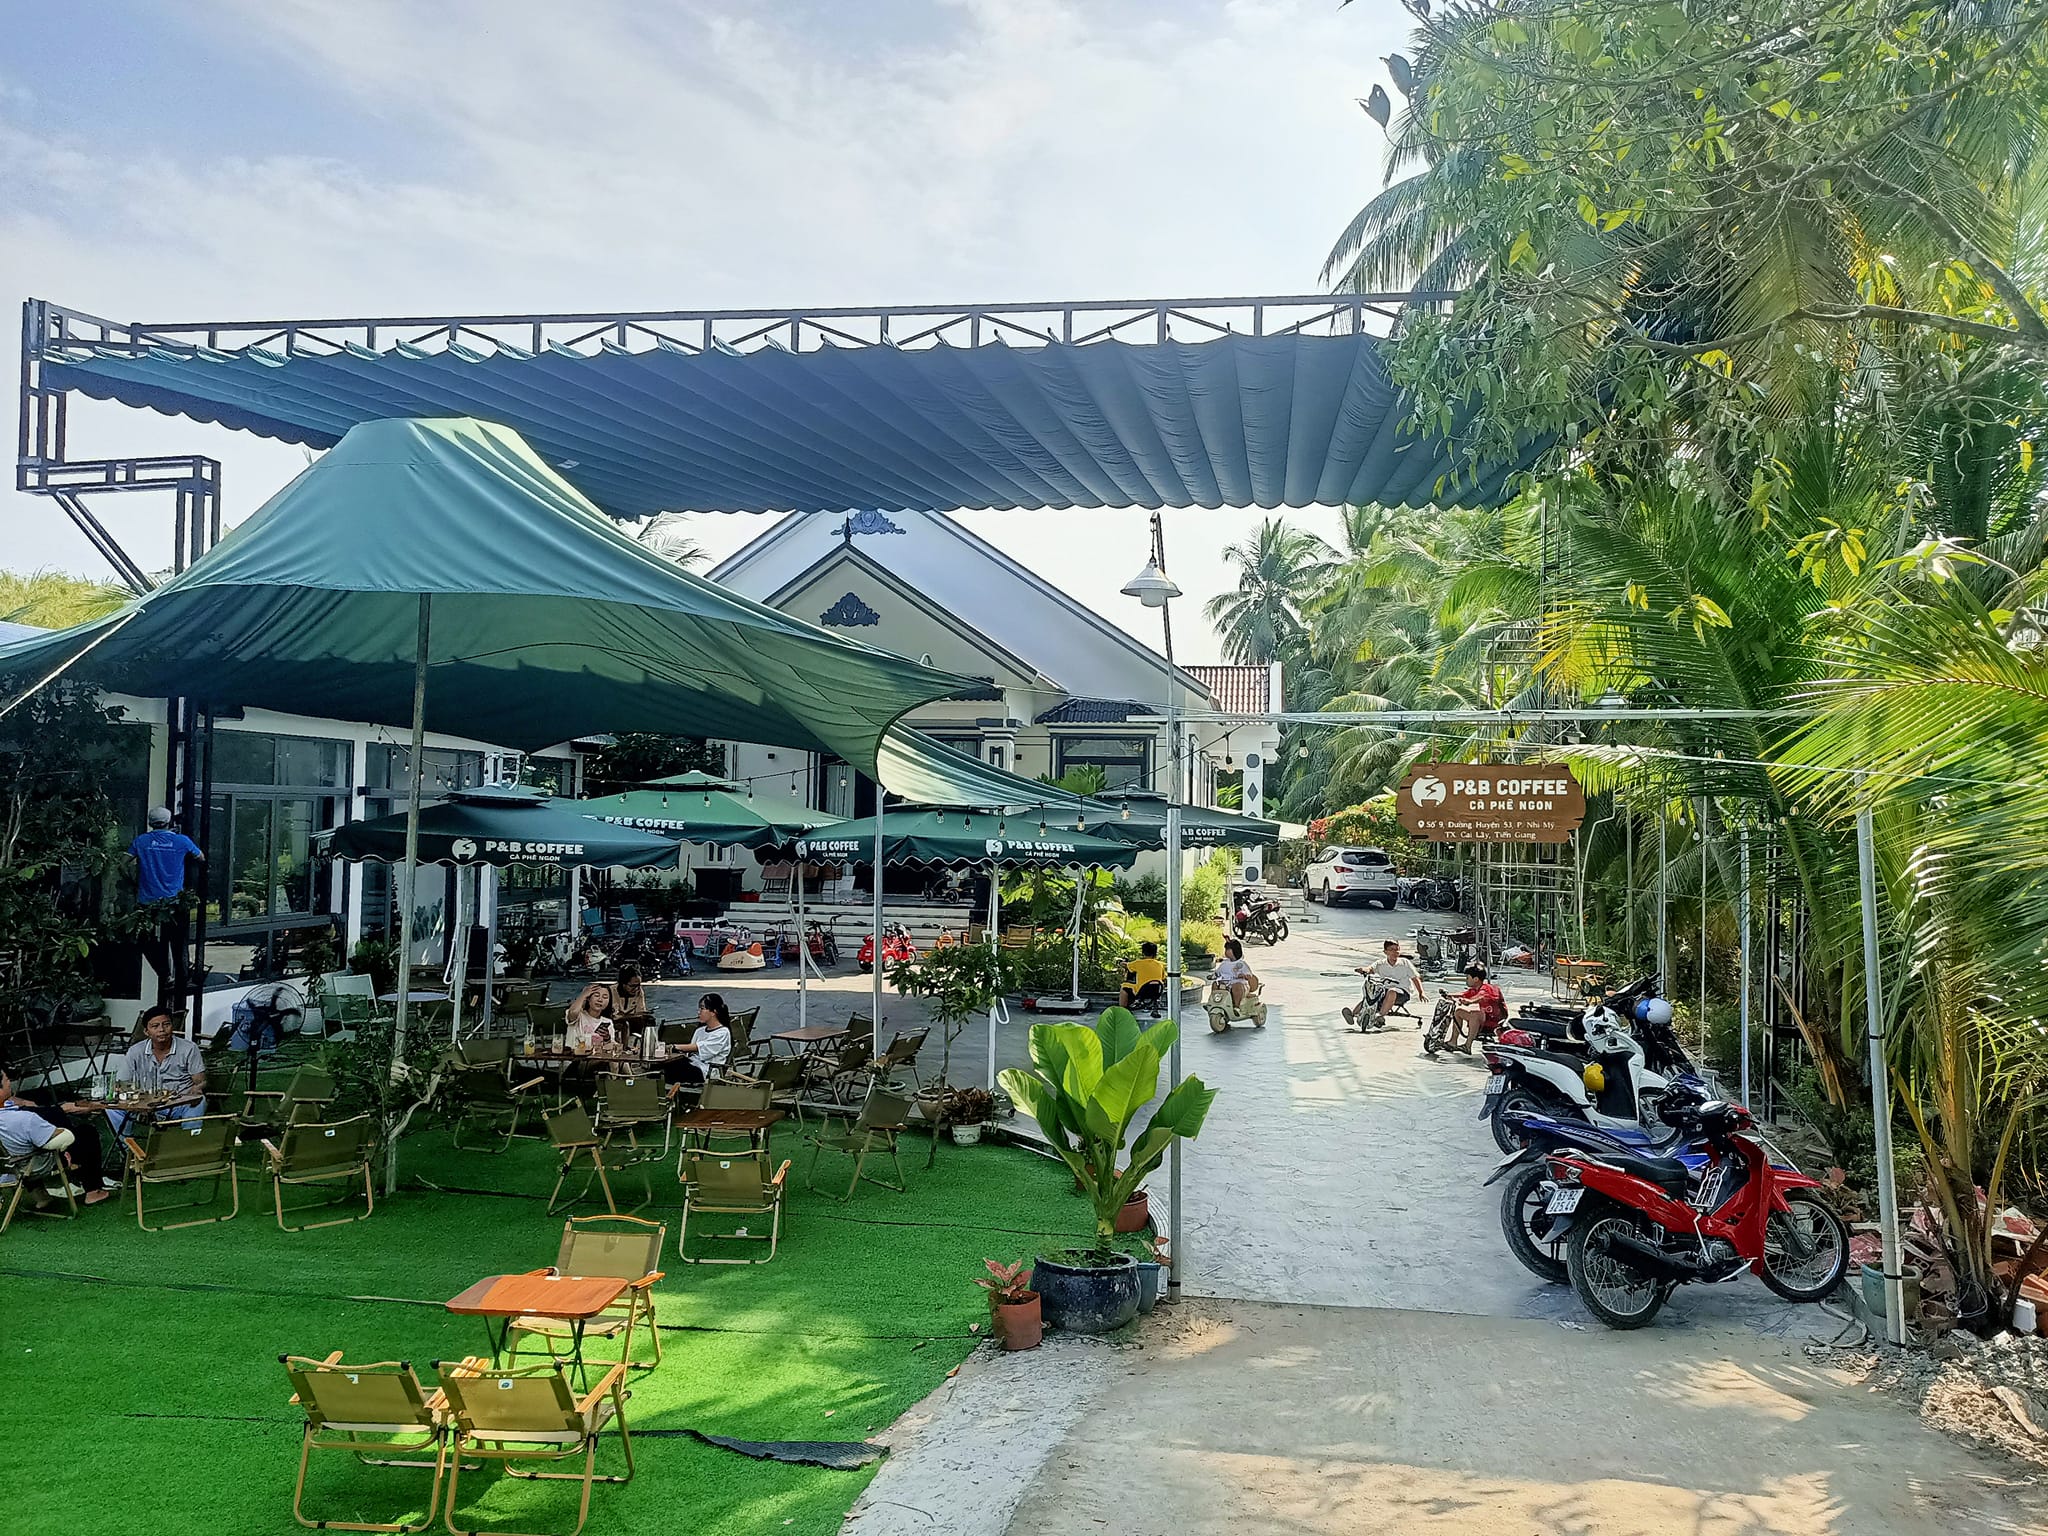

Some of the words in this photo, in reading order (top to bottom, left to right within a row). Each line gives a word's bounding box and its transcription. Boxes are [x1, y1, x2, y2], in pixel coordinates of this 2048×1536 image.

[1453, 780, 1490, 796] P&B
[1496, 780, 1568, 796] COFFEE
[1470, 799, 1485, 810] CÀ
[1490, 798, 1514, 810] PHÊ
[1520, 801, 1552, 810] NGON
[604, 816, 633, 826] P&B
[635, 818, 685, 830] COFFEE
[1196, 828, 1226, 836] COFFEE
[1514, 831, 1537, 840] Giang
[485, 840, 522, 852] P&B
[525, 842, 584, 854] COFFEE
[810, 841, 827, 851] P&B
[828, 841, 859, 851] COFFEE
[1007, 840, 1033, 850] P&B
[1034, 841, 1075, 852] COFFEE
